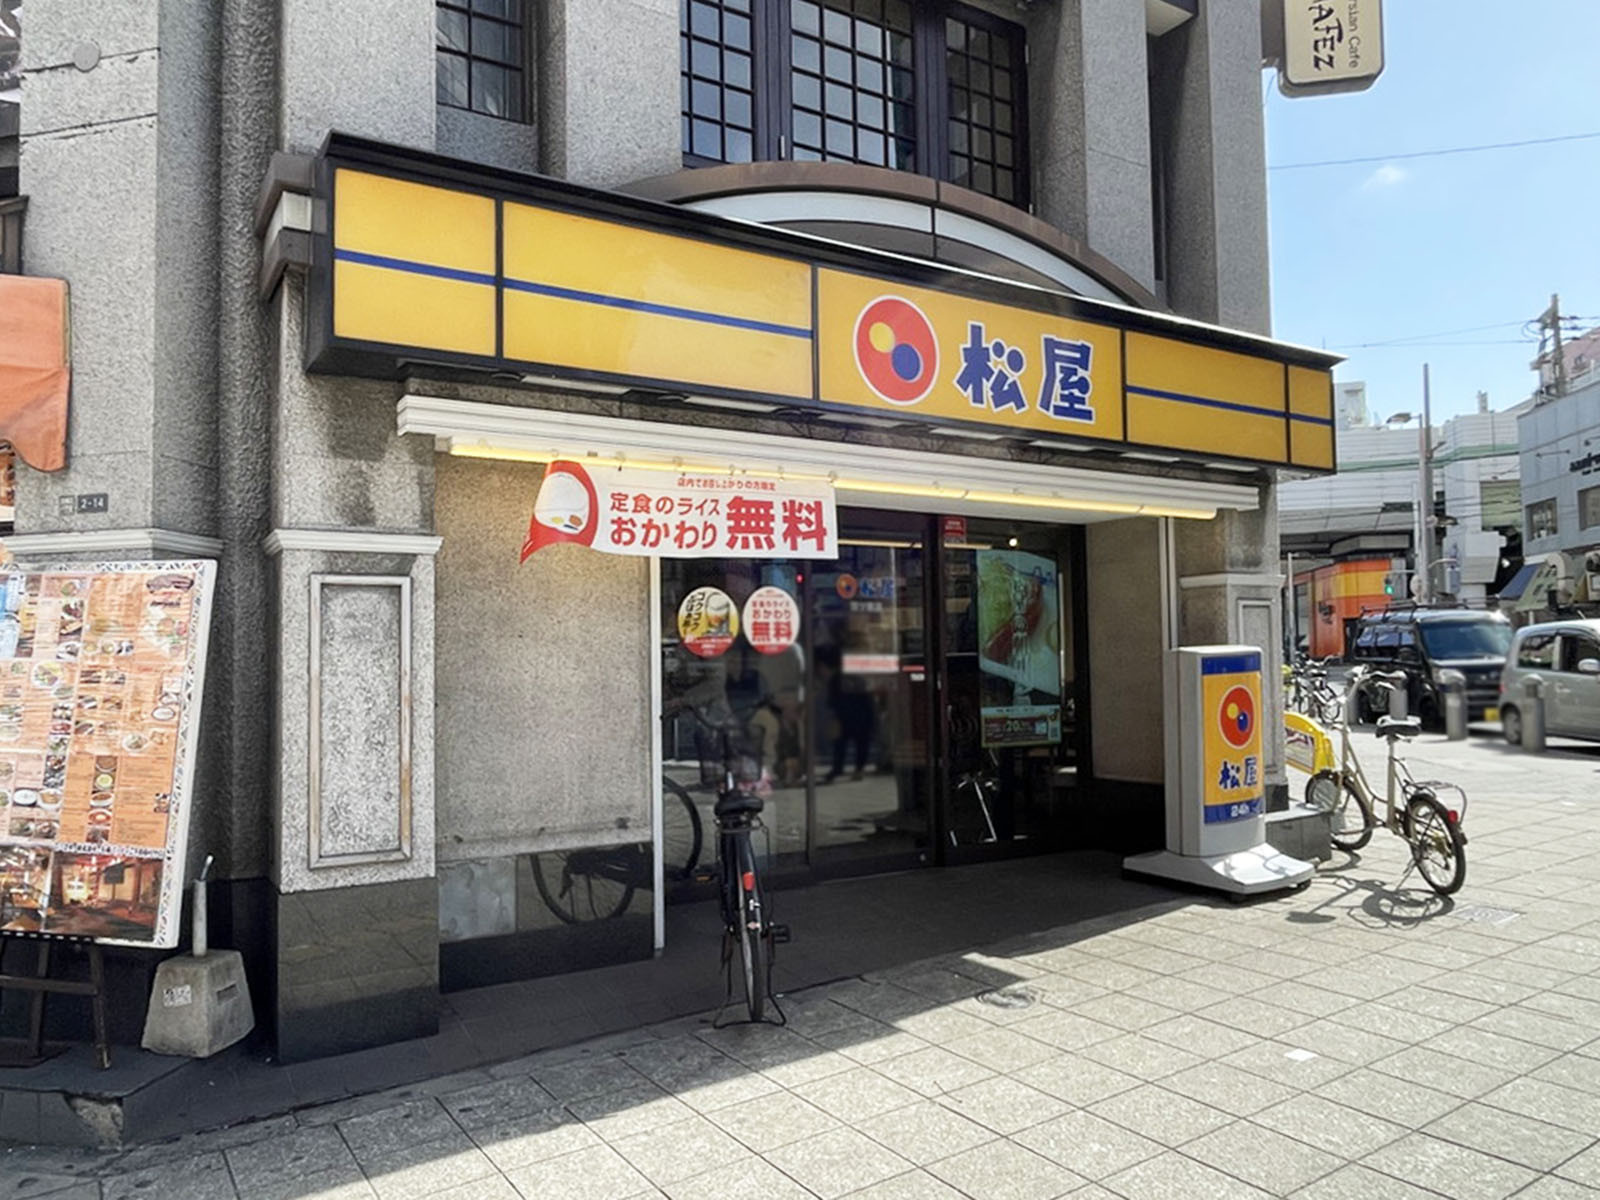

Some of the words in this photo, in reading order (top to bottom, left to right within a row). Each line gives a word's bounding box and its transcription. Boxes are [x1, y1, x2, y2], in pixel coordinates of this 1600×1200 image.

[1308, 0, 1344, 71] AFEZ
[953, 321, 1096, 424] 松屋
[80, 497, 105, 509] 2-14
[609, 491, 720, 517] 定食のライス
[609, 516, 719, 549] おかわり
[726, 495, 828, 552] 無料
[751, 621, 792, 642] 無料
[1219, 757, 1257, 789] 松屋
